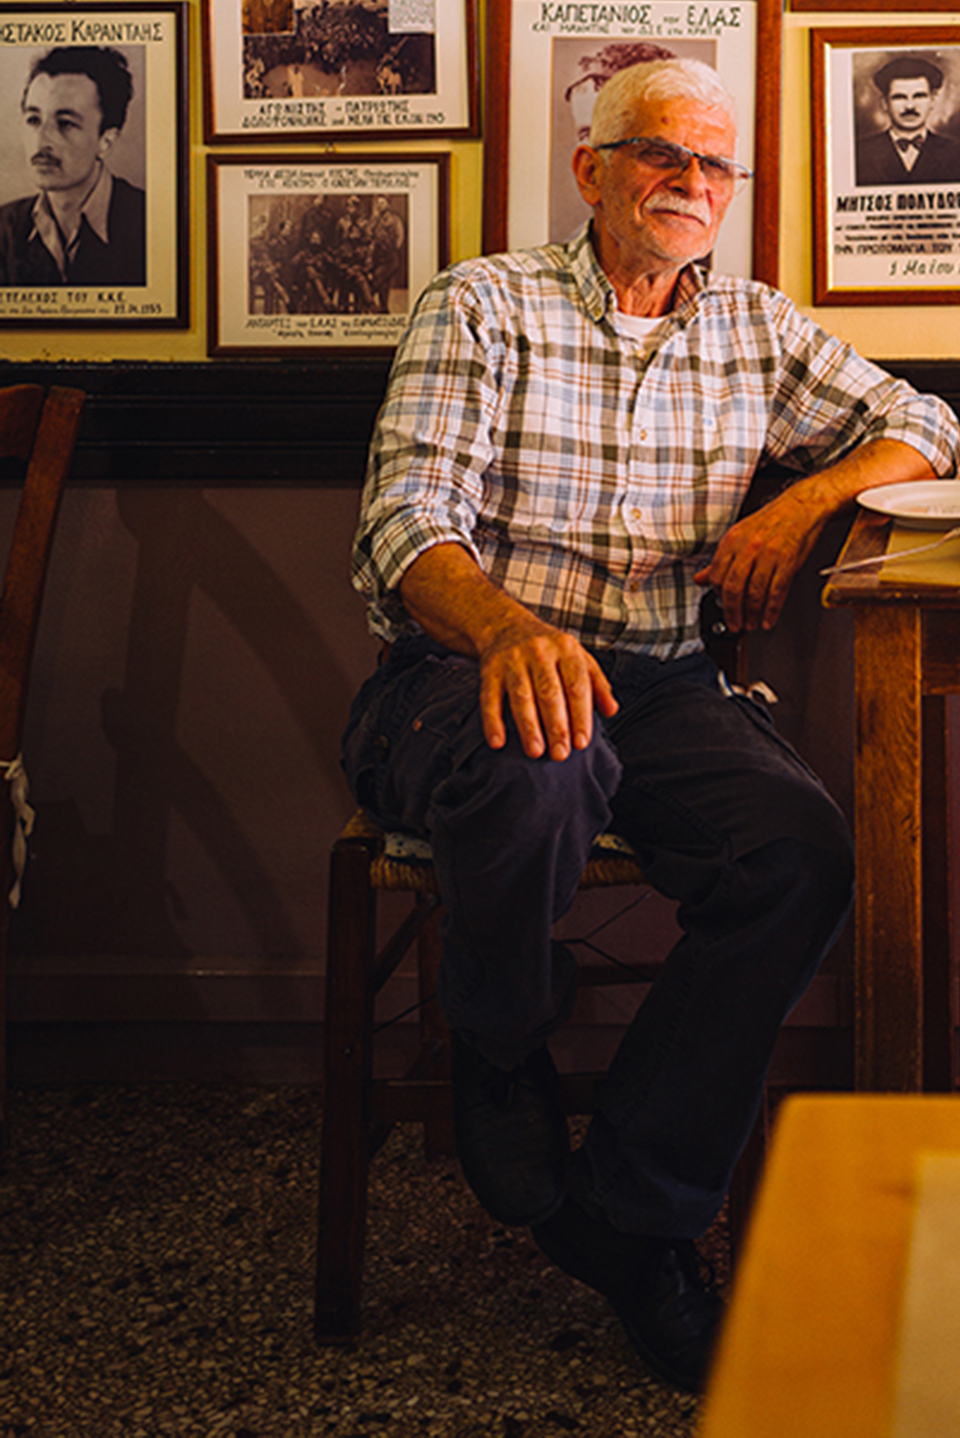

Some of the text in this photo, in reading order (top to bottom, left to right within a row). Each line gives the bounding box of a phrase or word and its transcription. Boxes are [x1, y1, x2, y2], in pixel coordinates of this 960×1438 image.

[541, 3, 652, 25] ΚΑΠΕΤΑΝΙΟΣ
[687, 5, 742, 28] ΕΛΑΣ
[836, 193, 893, 212] ΜΗΤΣΟΣ
